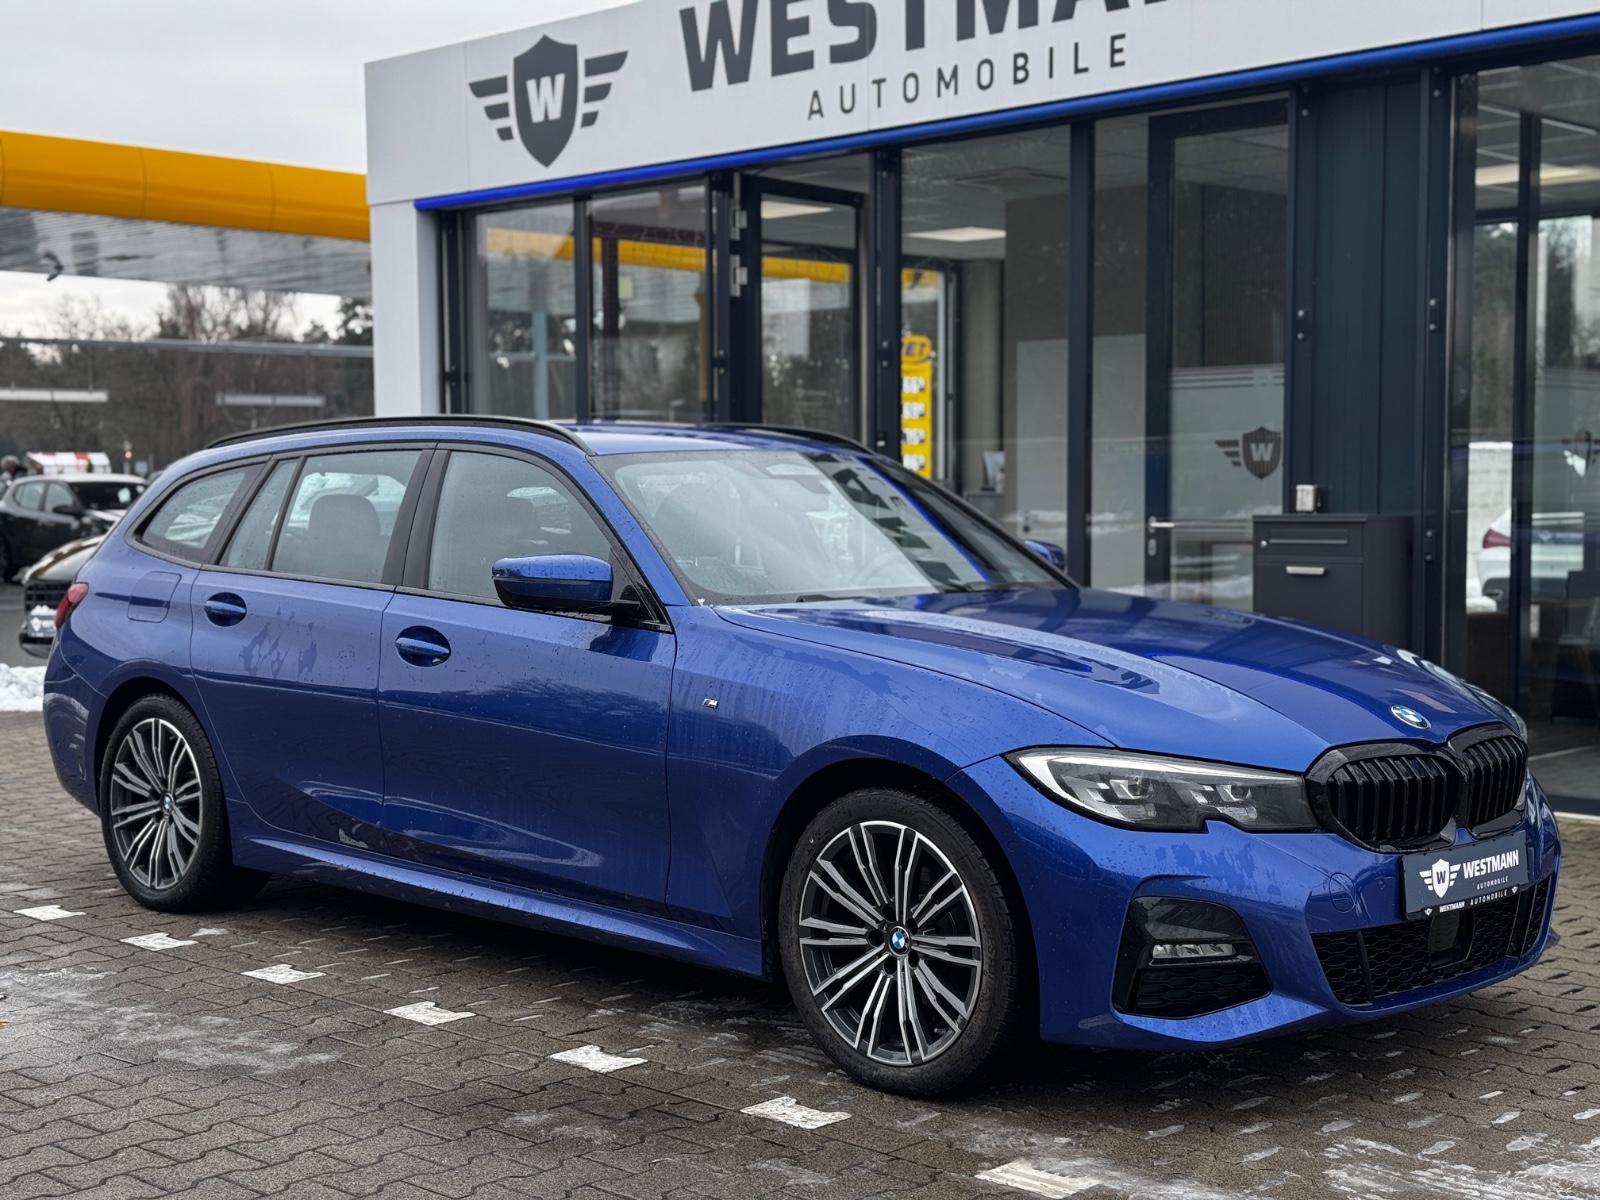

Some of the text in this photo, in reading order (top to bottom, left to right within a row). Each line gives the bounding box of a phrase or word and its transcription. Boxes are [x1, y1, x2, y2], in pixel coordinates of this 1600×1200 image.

[807, 33, 1127, 121] AUTOMOBILE
[525, 72, 566, 124] W
[1249, 442, 1274, 462] W
[1463, 850, 1519, 879] WESTMANN
[1436, 870, 1446, 885] W
[1477, 876, 1508, 890] AUTOMOBILE
[1470, 889, 1507, 905] AUTOMOBILE
